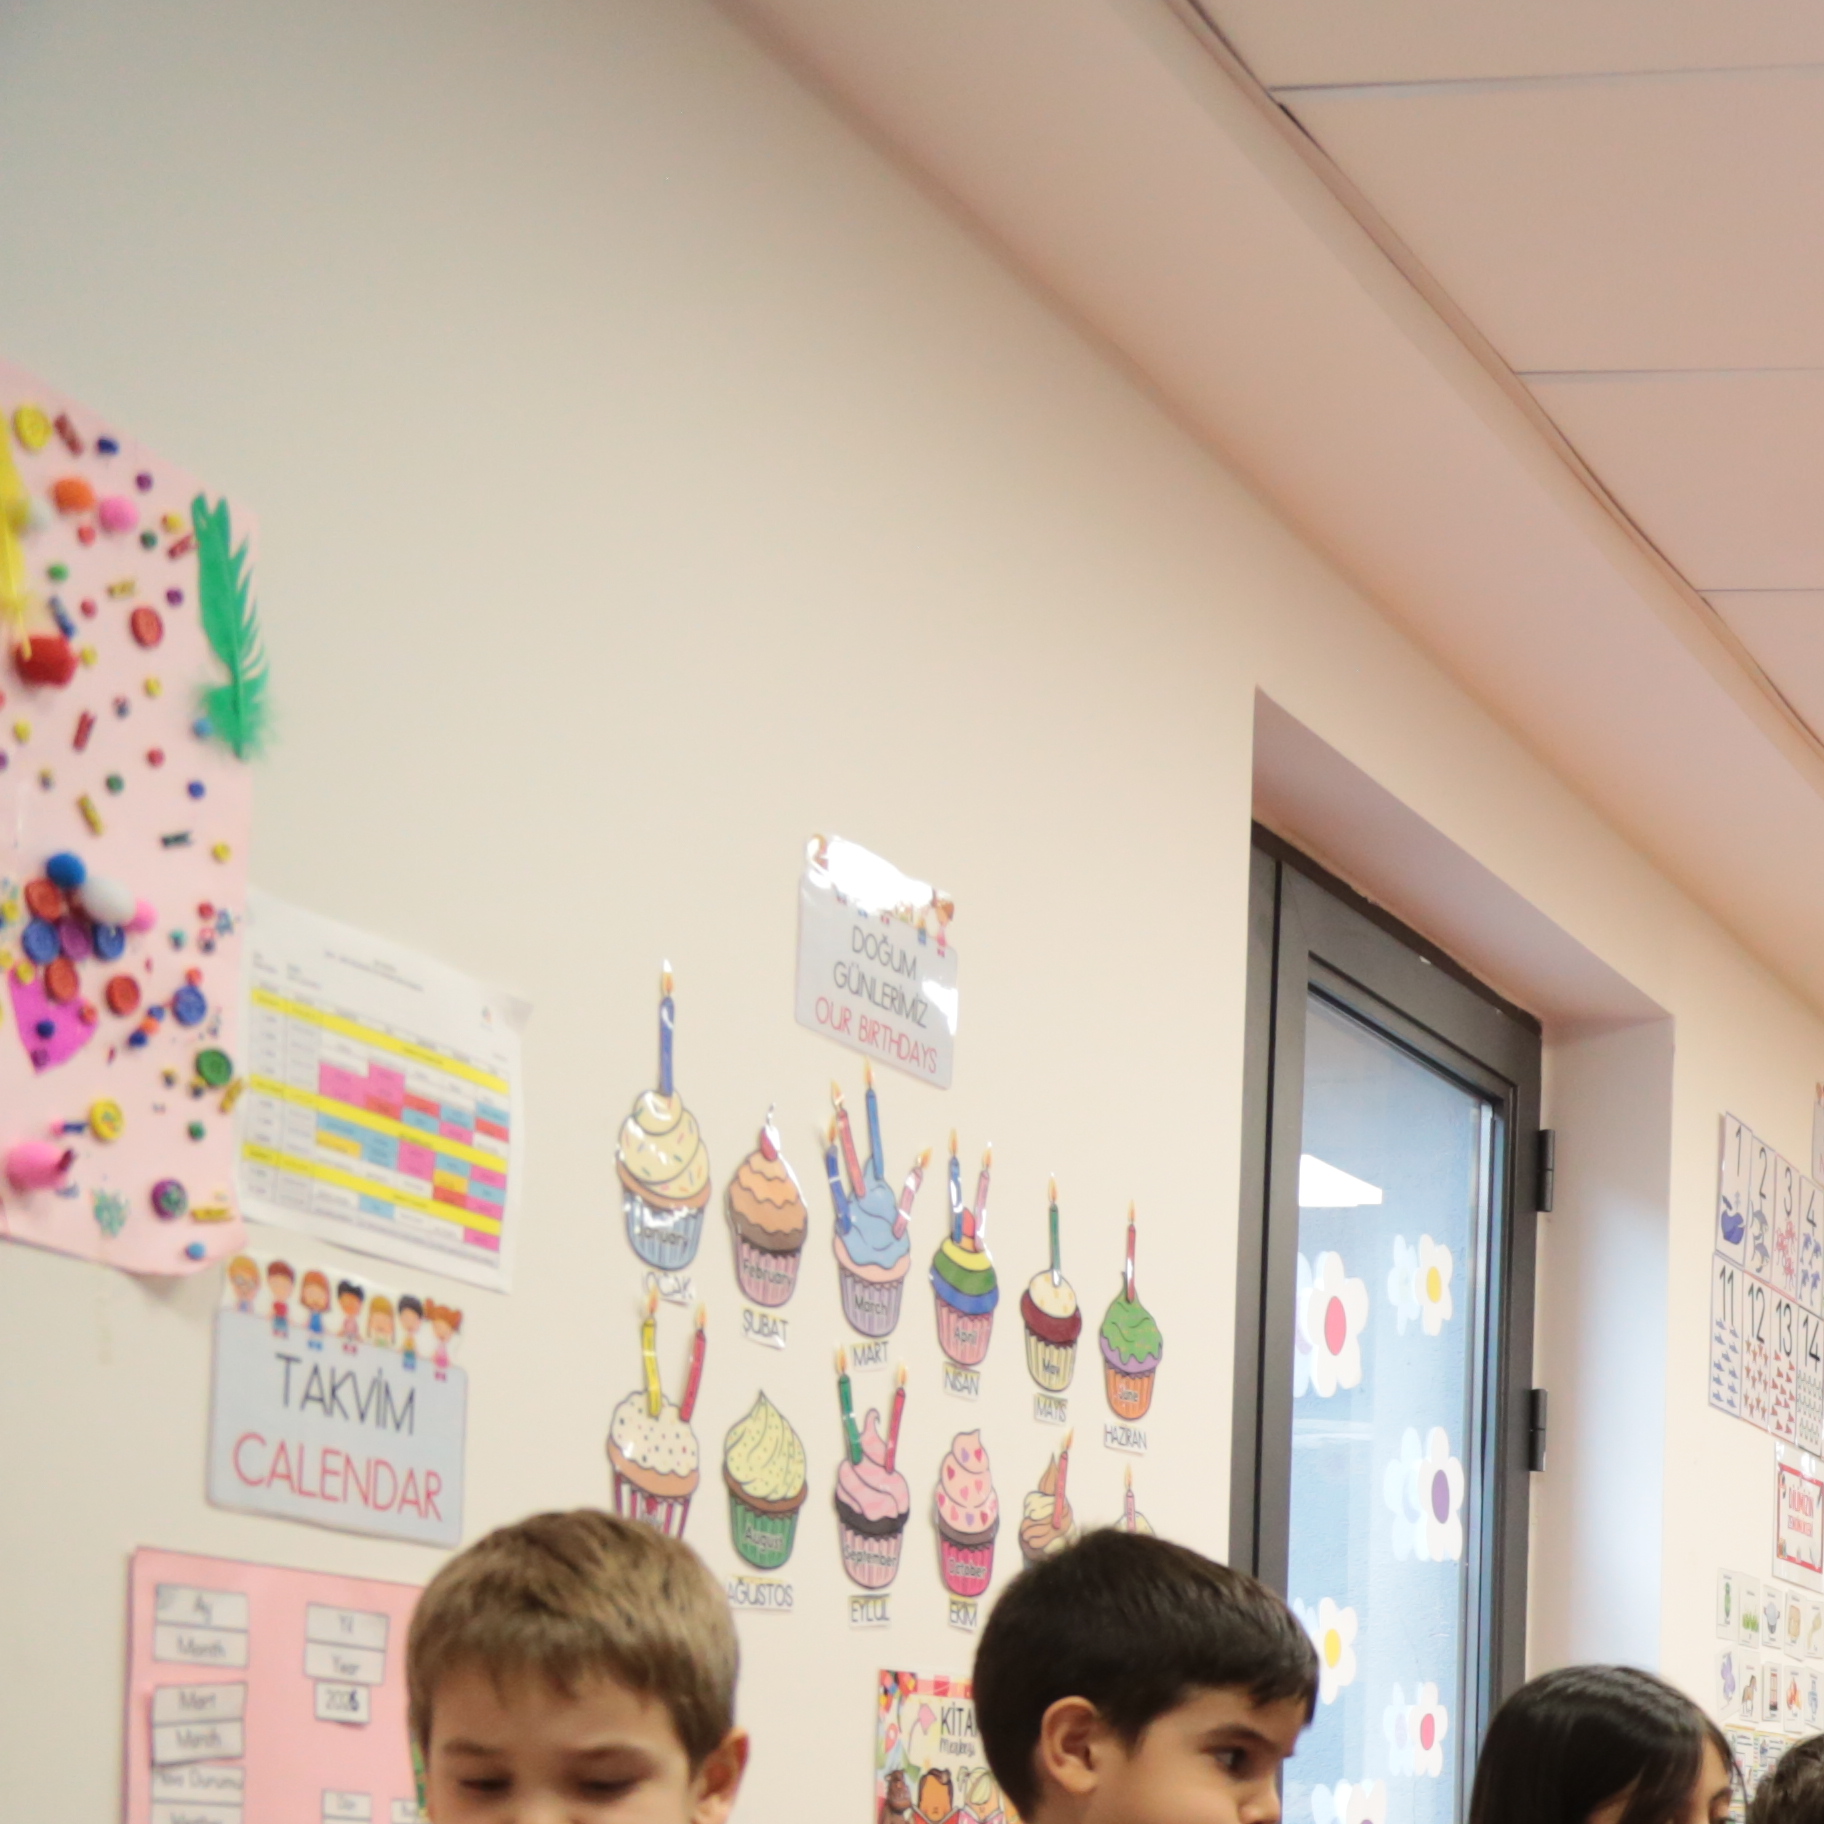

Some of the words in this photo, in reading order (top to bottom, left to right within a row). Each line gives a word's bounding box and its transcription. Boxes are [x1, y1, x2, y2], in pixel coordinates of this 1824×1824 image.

[852, 925, 917, 980] DOĞUM
[833, 961, 928, 1029] GÜNLERİMİZ
[815, 996, 852, 1035] OUR
[858, 1015, 938, 1074] BIRTHDAYS
[1735, 1125, 1742, 1177] 1
[1759, 1147, 1767, 1199] 2
[1784, 1166, 1793, 1217] 3
[1806, 1190, 1817, 1236] 4
[743, 1260, 794, 1287] February
[854, 1296, 888, 1315] March
[1719, 1265, 1734, 1326] 11
[1748, 1283, 1766, 1344] 12
[1776, 1299, 1793, 1357] 13
[1803, 1314, 1821, 1373] 14
[742, 1312, 789, 1342] ŞUBAT
[954, 1328, 978, 1347] April
[853, 1341, 890, 1366] MART
[1042, 1358, 1061, 1377] May
[275, 1352, 416, 1435] TAKVİM
[233, 1432, 442, 1522] CALENDAR
[744, 1525, 784, 1553] August
[843, 1549, 898, 1573] September
[948, 1557, 987, 1579] October
[941, 1701, 977, 1737] KİTA
